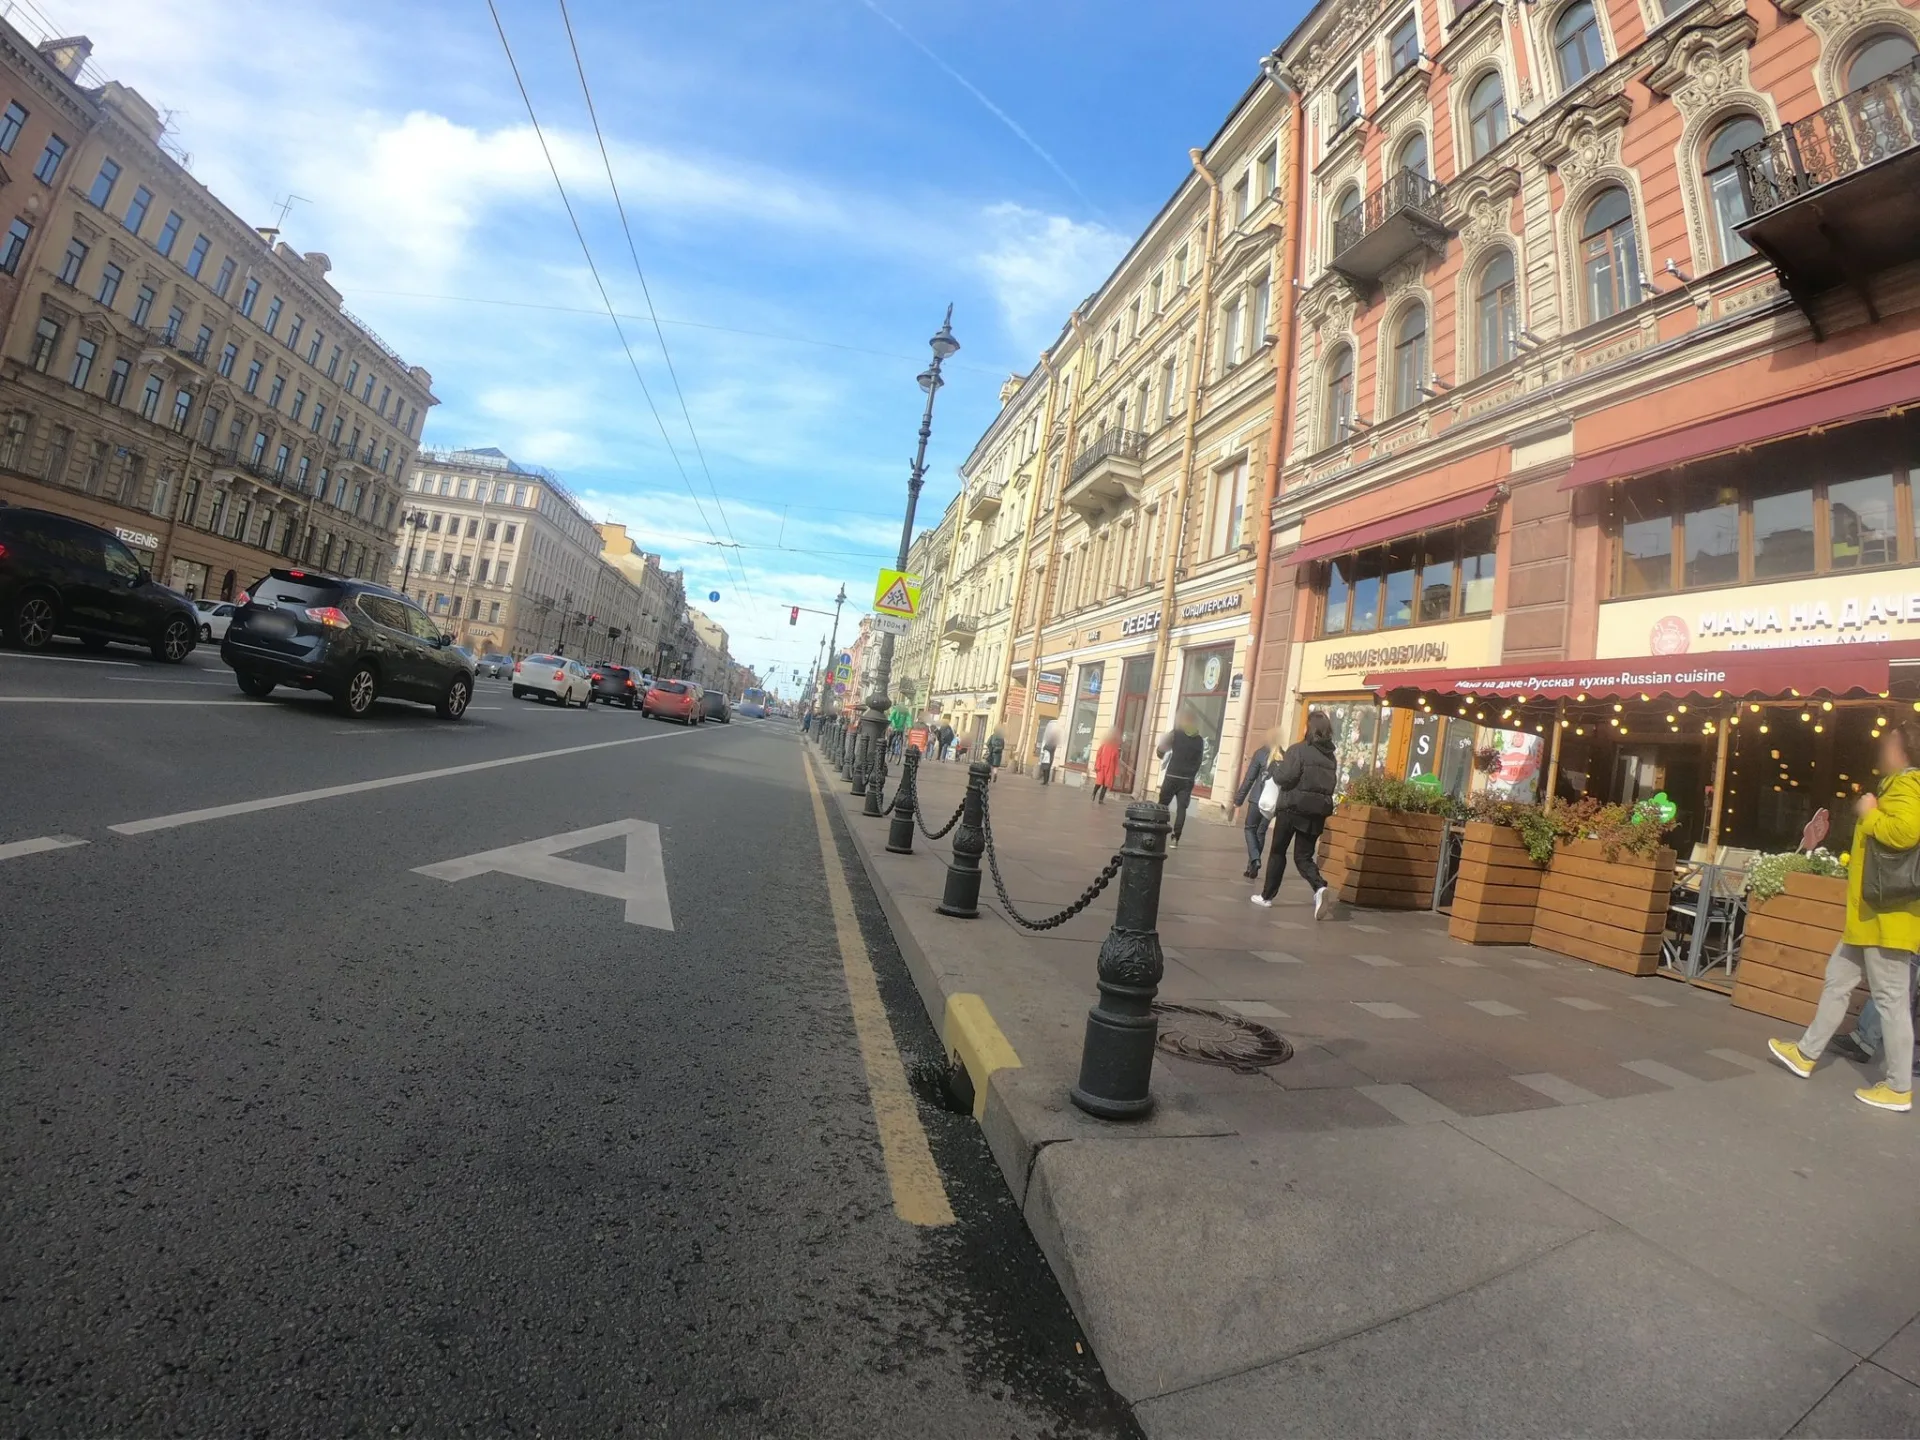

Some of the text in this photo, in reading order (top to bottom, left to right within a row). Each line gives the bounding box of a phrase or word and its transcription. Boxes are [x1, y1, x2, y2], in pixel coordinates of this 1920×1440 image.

[115, 527, 158, 548] TEZENIS
[1181, 594, 1242, 618] КОНДИТЕРСКАЯ
[1698, 592, 1920, 637] МАМА НА ДАЧЕ
[1325, 641, 1448, 670] НЕВСКИЕ ЮВЕЛИРЫ
[1527, 677, 1575, 691] Русская
[1579, 676, 1615, 690] кухня
[1621, 672, 1672, 685] Russian
[1674, 669, 1726, 683] cuisine
[1459, 737, 1472, 748] 5%
